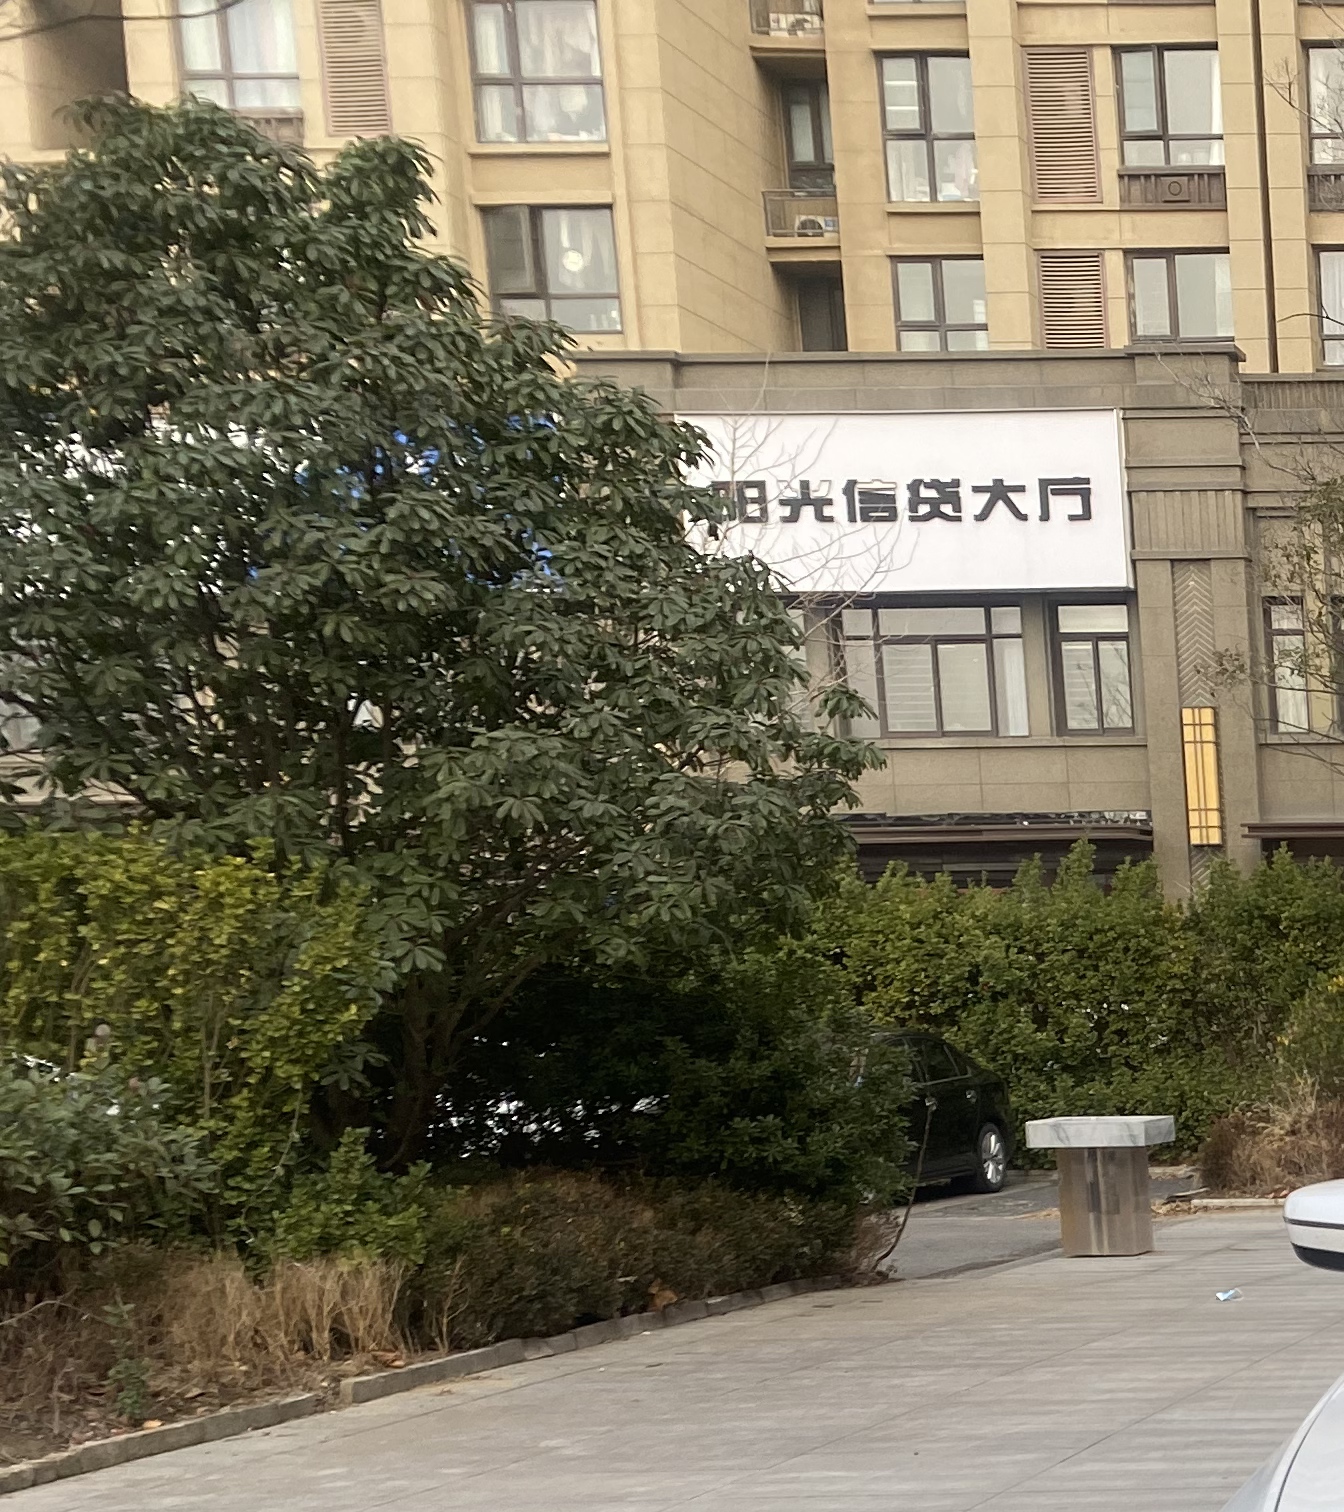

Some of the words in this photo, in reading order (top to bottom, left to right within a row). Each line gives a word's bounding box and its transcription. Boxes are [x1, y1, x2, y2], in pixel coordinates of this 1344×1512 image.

[710, 477, 1092, 523] 阳光信贷大厅
